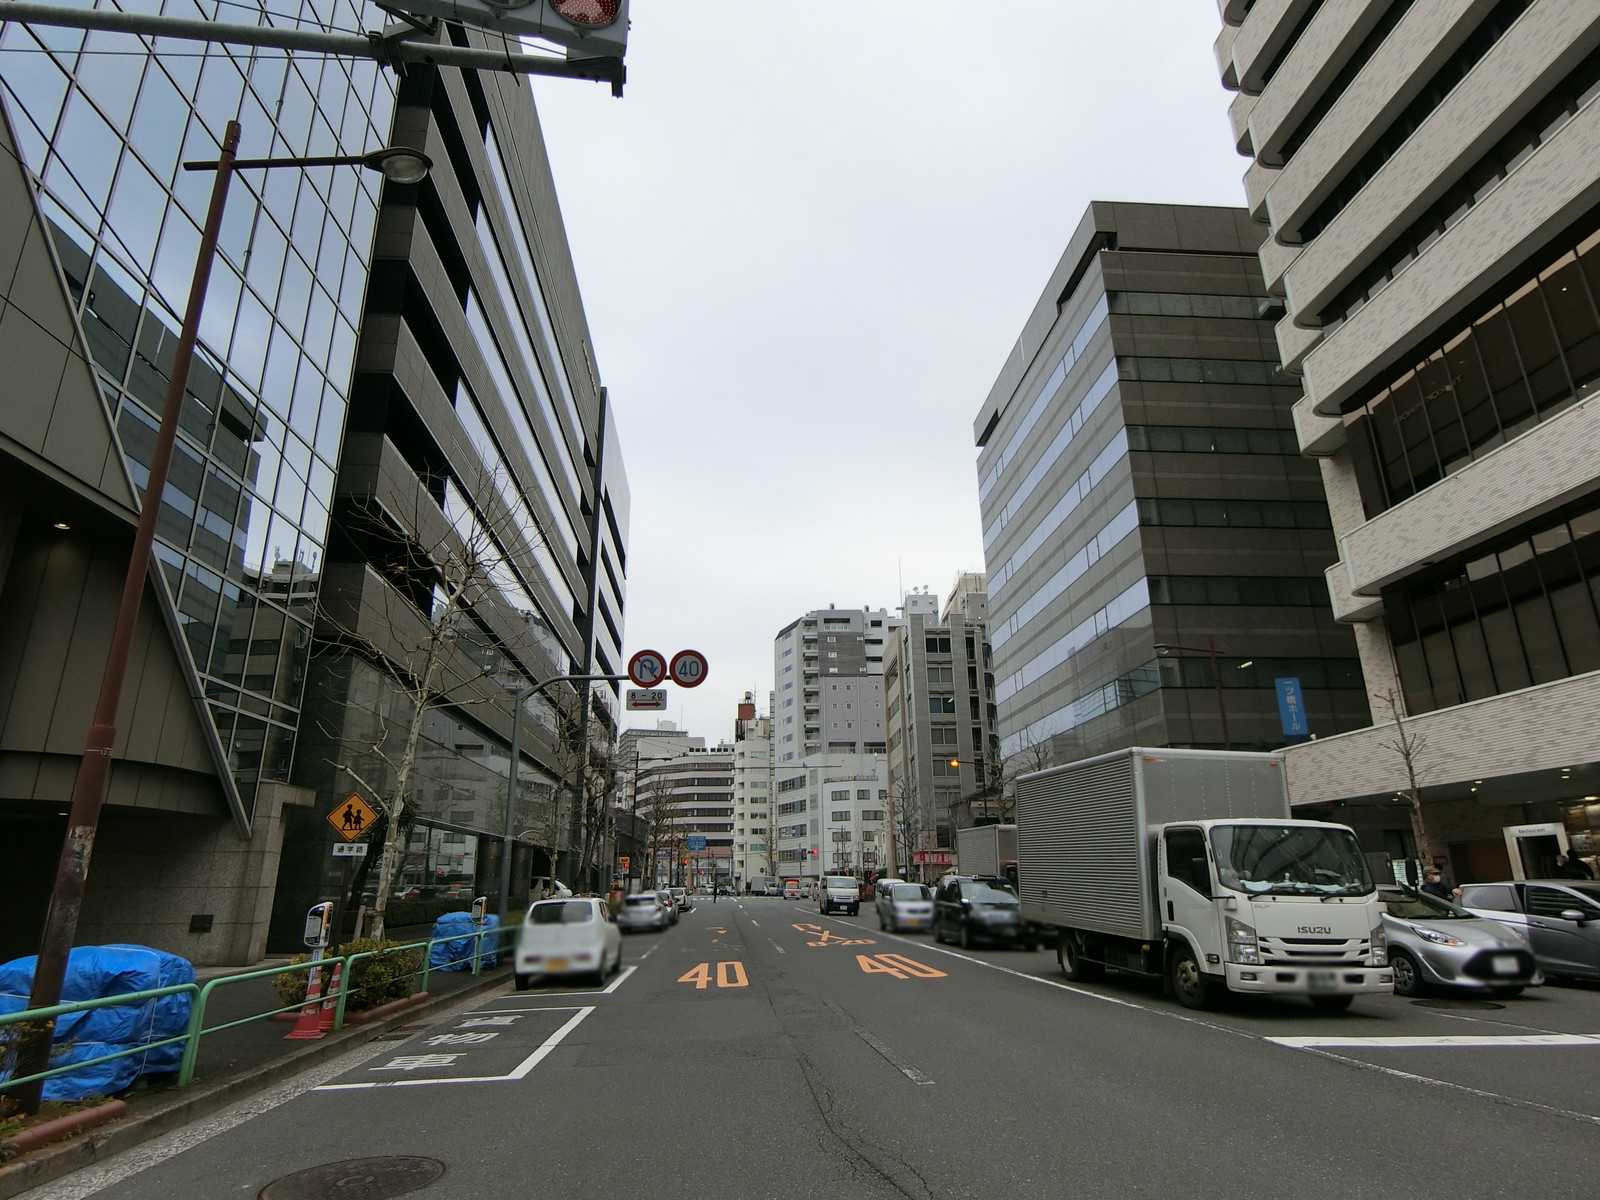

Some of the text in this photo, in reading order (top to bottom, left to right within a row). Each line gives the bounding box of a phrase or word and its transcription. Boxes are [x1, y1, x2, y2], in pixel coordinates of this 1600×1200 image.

[679, 661, 699, 677] 40
[337, 846, 363, 854] 通学路
[1297, 925, 1331, 934] ISUZU
[856, 953, 948, 979] 40
[677, 961, 749, 989] 40
